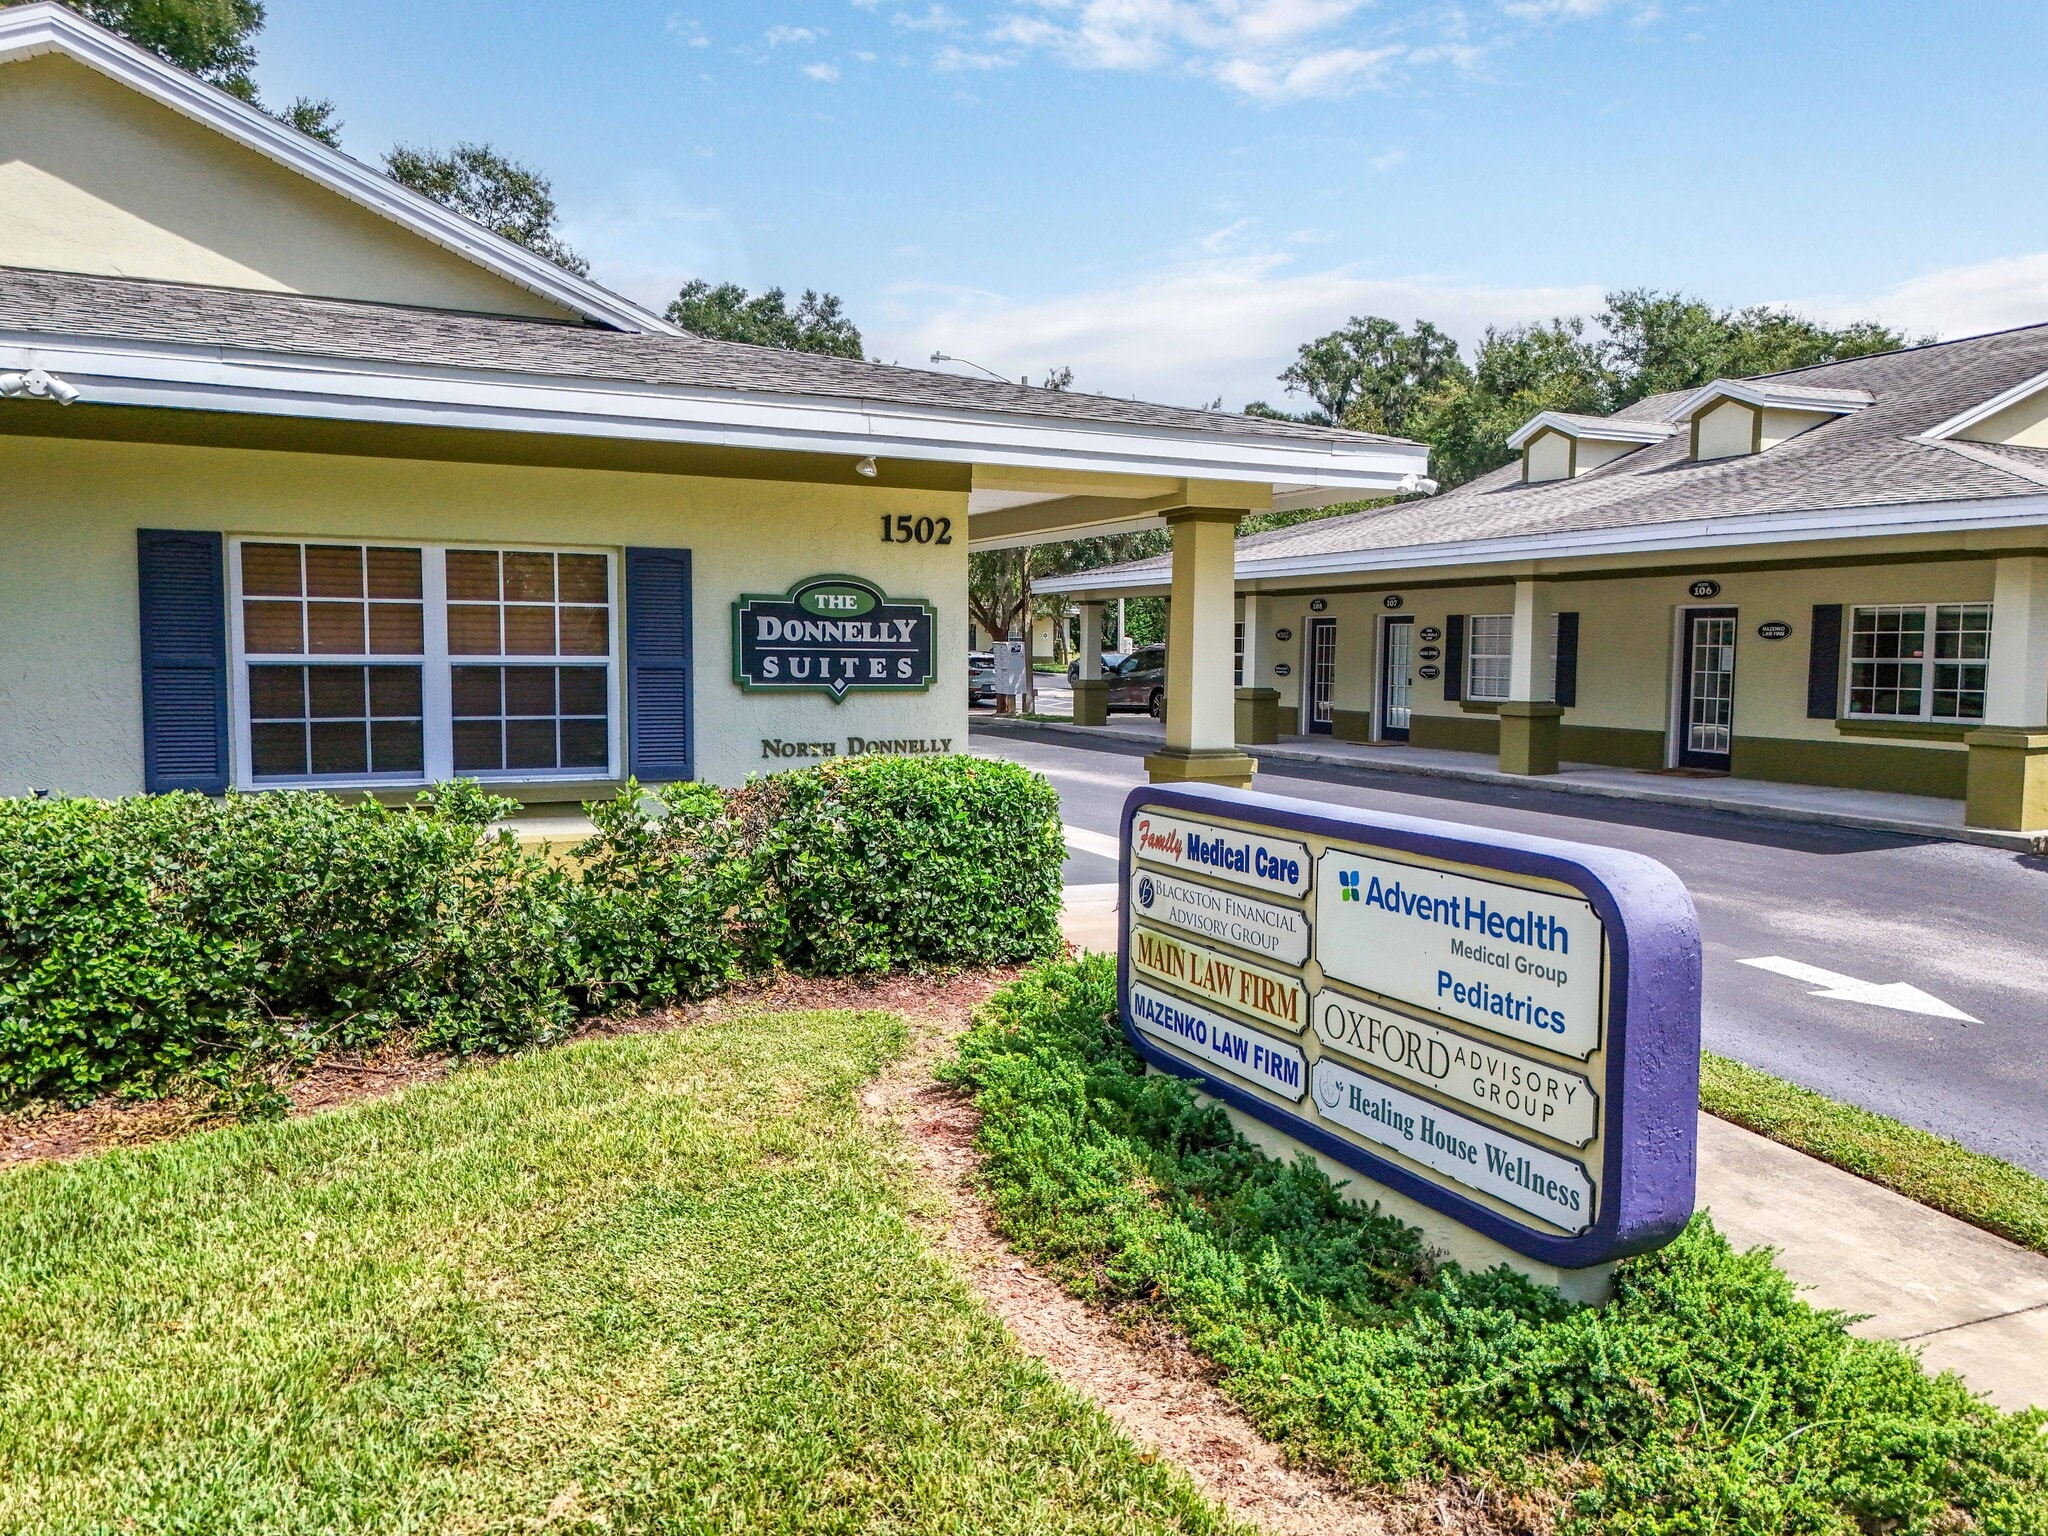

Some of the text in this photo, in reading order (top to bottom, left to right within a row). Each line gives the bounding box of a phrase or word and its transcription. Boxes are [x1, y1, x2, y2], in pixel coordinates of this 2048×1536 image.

[880, 514, 953, 545] 1502
[814, 594, 858, 610] THE
[1386, 599, 1398, 607] 107
[1693, 586, 1713, 596] 106
[756, 616, 918, 643] DONNELLY
[762, 656, 914, 679] SUITES
[761, 736, 953, 758] NORTH DONNELLY
[1138, 819, 1300, 885] Family Medical Care
[1155, 879, 1297, 933] BLACKSTON FINANCIAL
[1168, 906, 1279, 952] ADVISORY GROUP
[1365, 875, 1569, 954] AdventHealth
[1137, 933, 1299, 1024] MAIN LAW FIRM
[1450, 938, 1569, 985] Medical Group
[1437, 970, 1567, 1034] Pediatrics
[1134, 993, 1299, 1088] MAZENKO LAW FIRM
[1324, 1003, 1578, 1106] OXFORD ADVISORY
[1473, 1079, 1555, 1123] GROUP
[1348, 1084, 1581, 1212] Healing House Wellness
